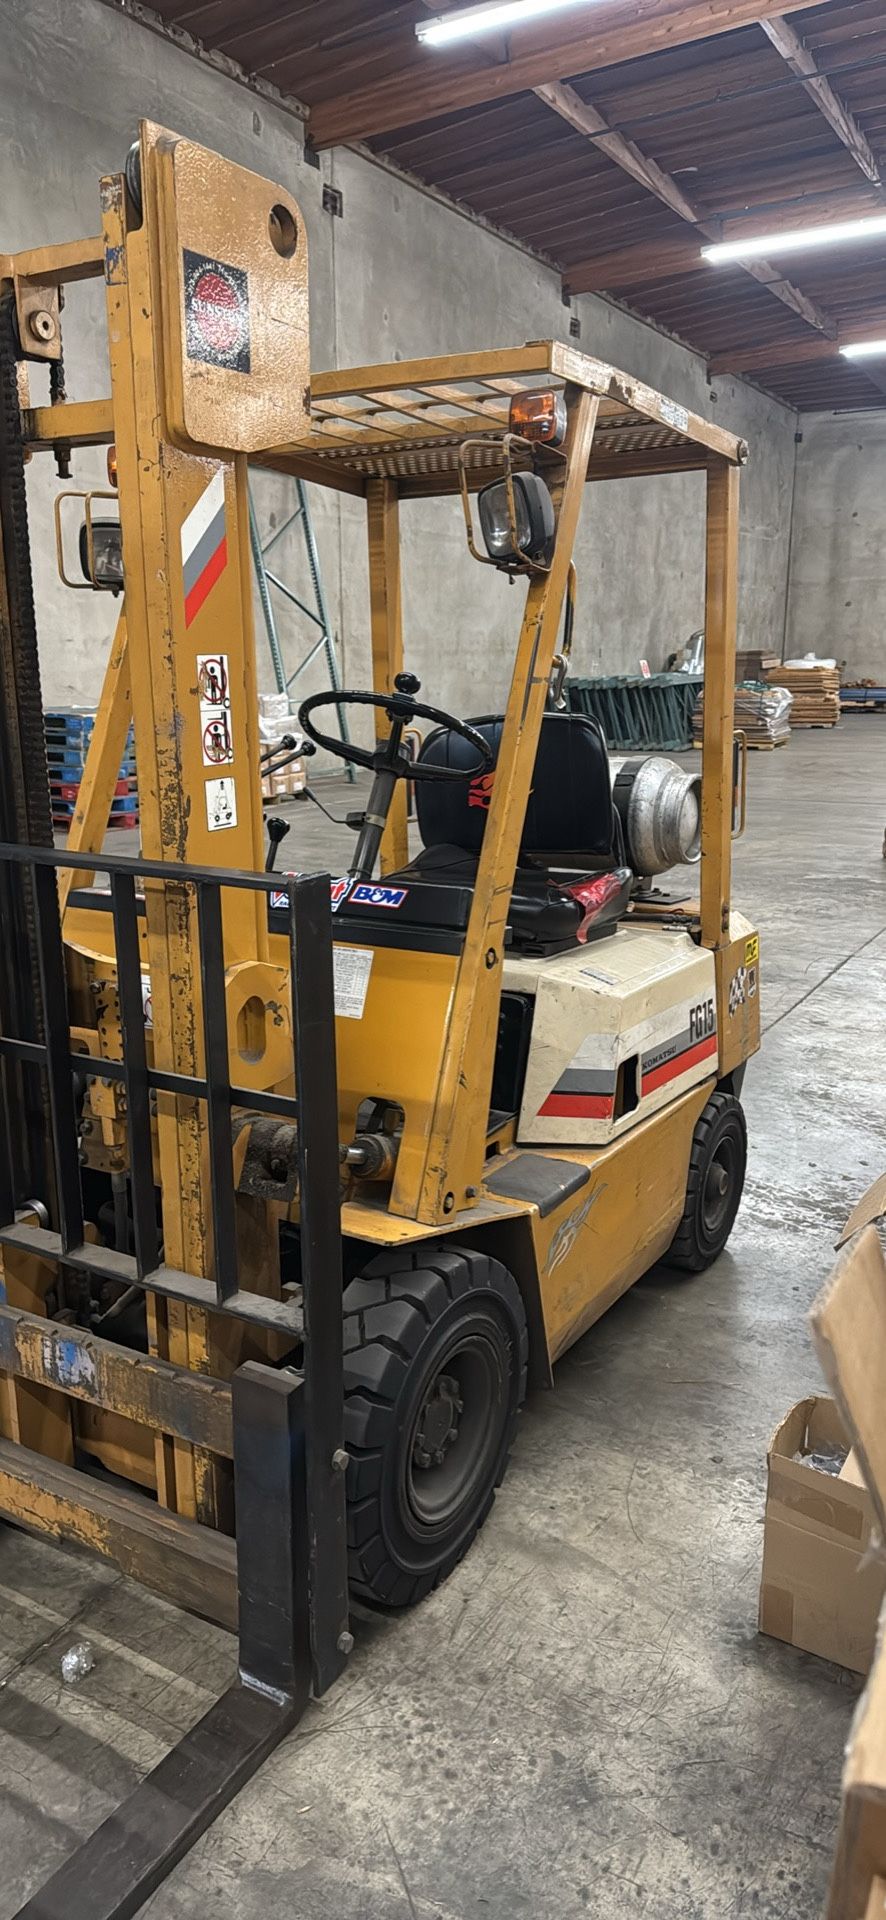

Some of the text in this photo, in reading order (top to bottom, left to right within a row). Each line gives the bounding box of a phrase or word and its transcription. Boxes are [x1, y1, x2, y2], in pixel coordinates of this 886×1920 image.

[352, 887, 405, 905] B&M
[689, 998, 714, 1043] FG15
[642, 1045, 677, 1069] KOMATSU
